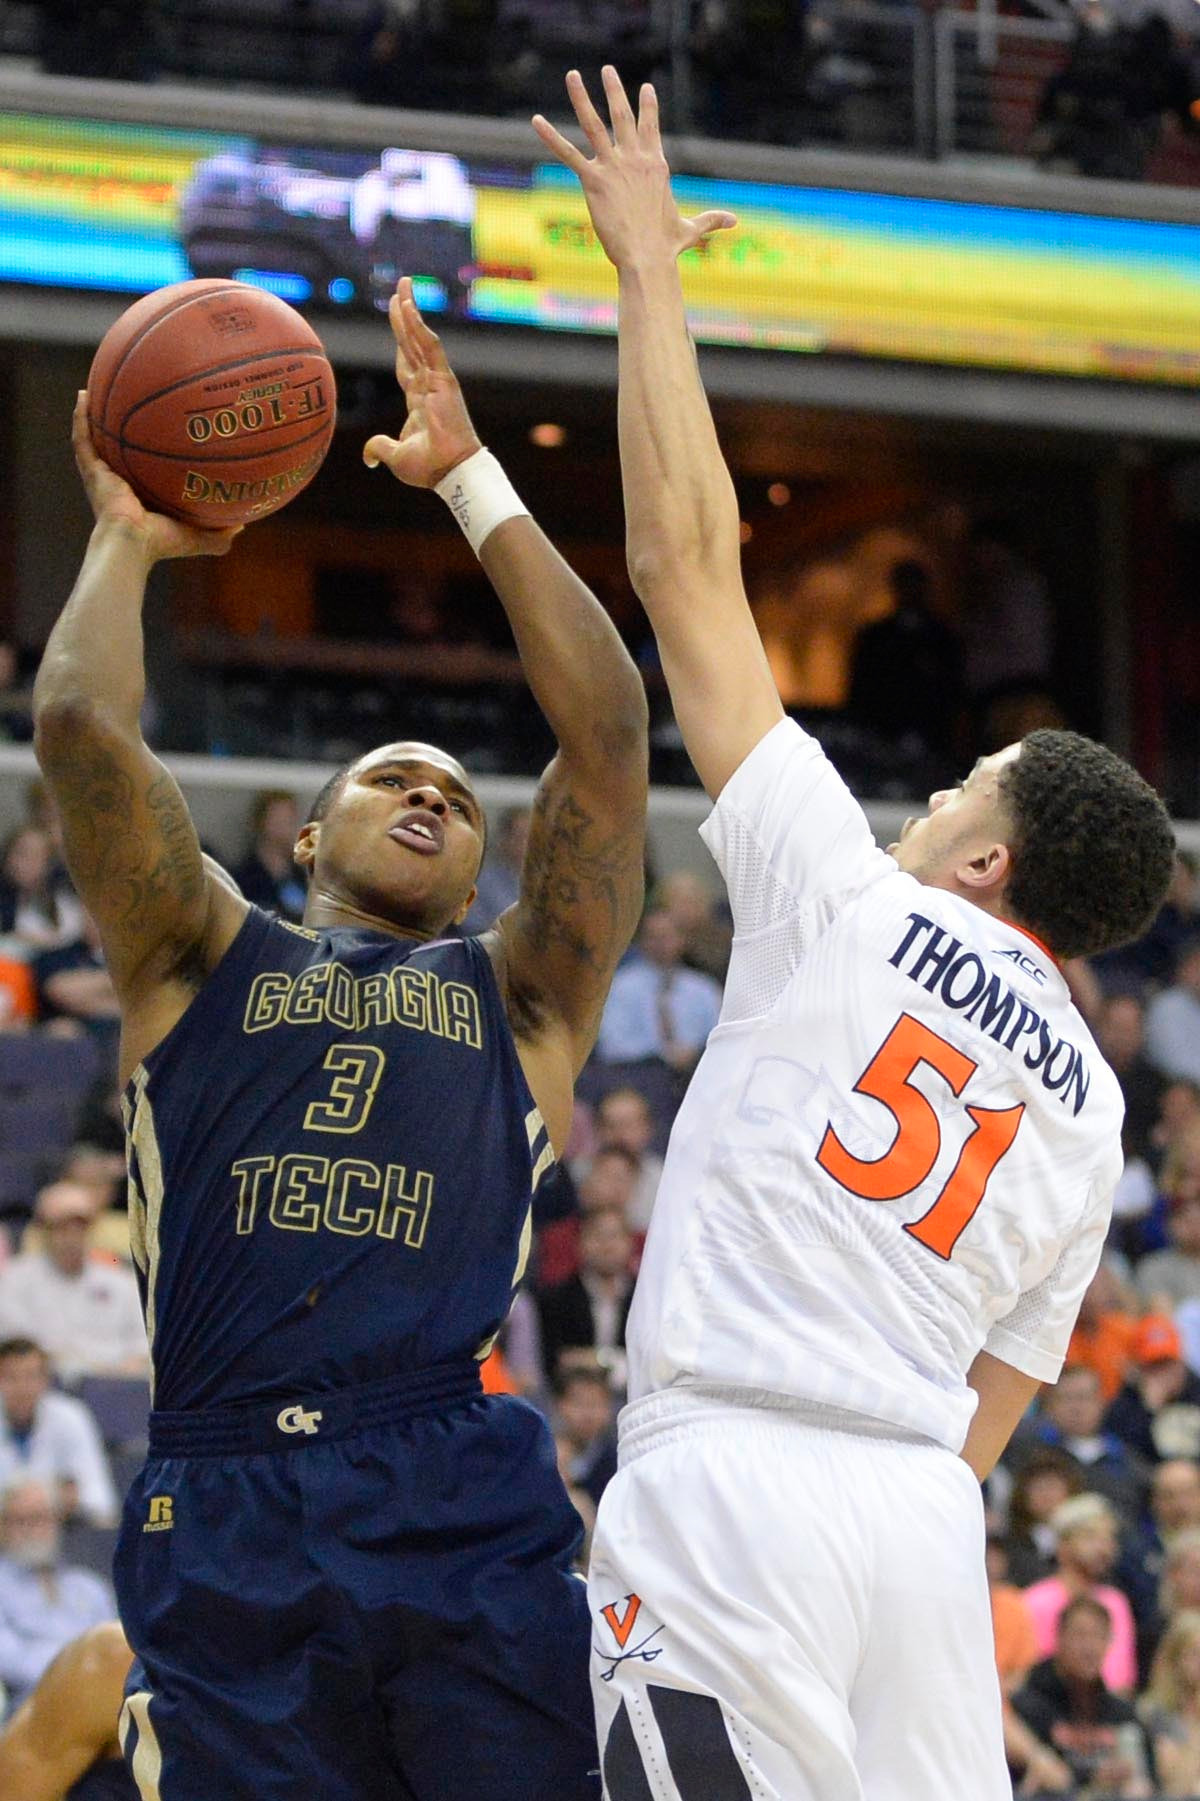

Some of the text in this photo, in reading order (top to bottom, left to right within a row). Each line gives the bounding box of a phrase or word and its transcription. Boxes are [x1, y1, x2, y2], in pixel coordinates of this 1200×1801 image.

[243, 961, 482, 1050] GEORGIA
[999, 949, 1048, 986] ACC
[887, 912, 1092, 1118] THOMPSON
[303, 1043, 386, 1135] 3
[816, 1011, 1027, 1261] 51
[231, 1153, 434, 1249] TECH
